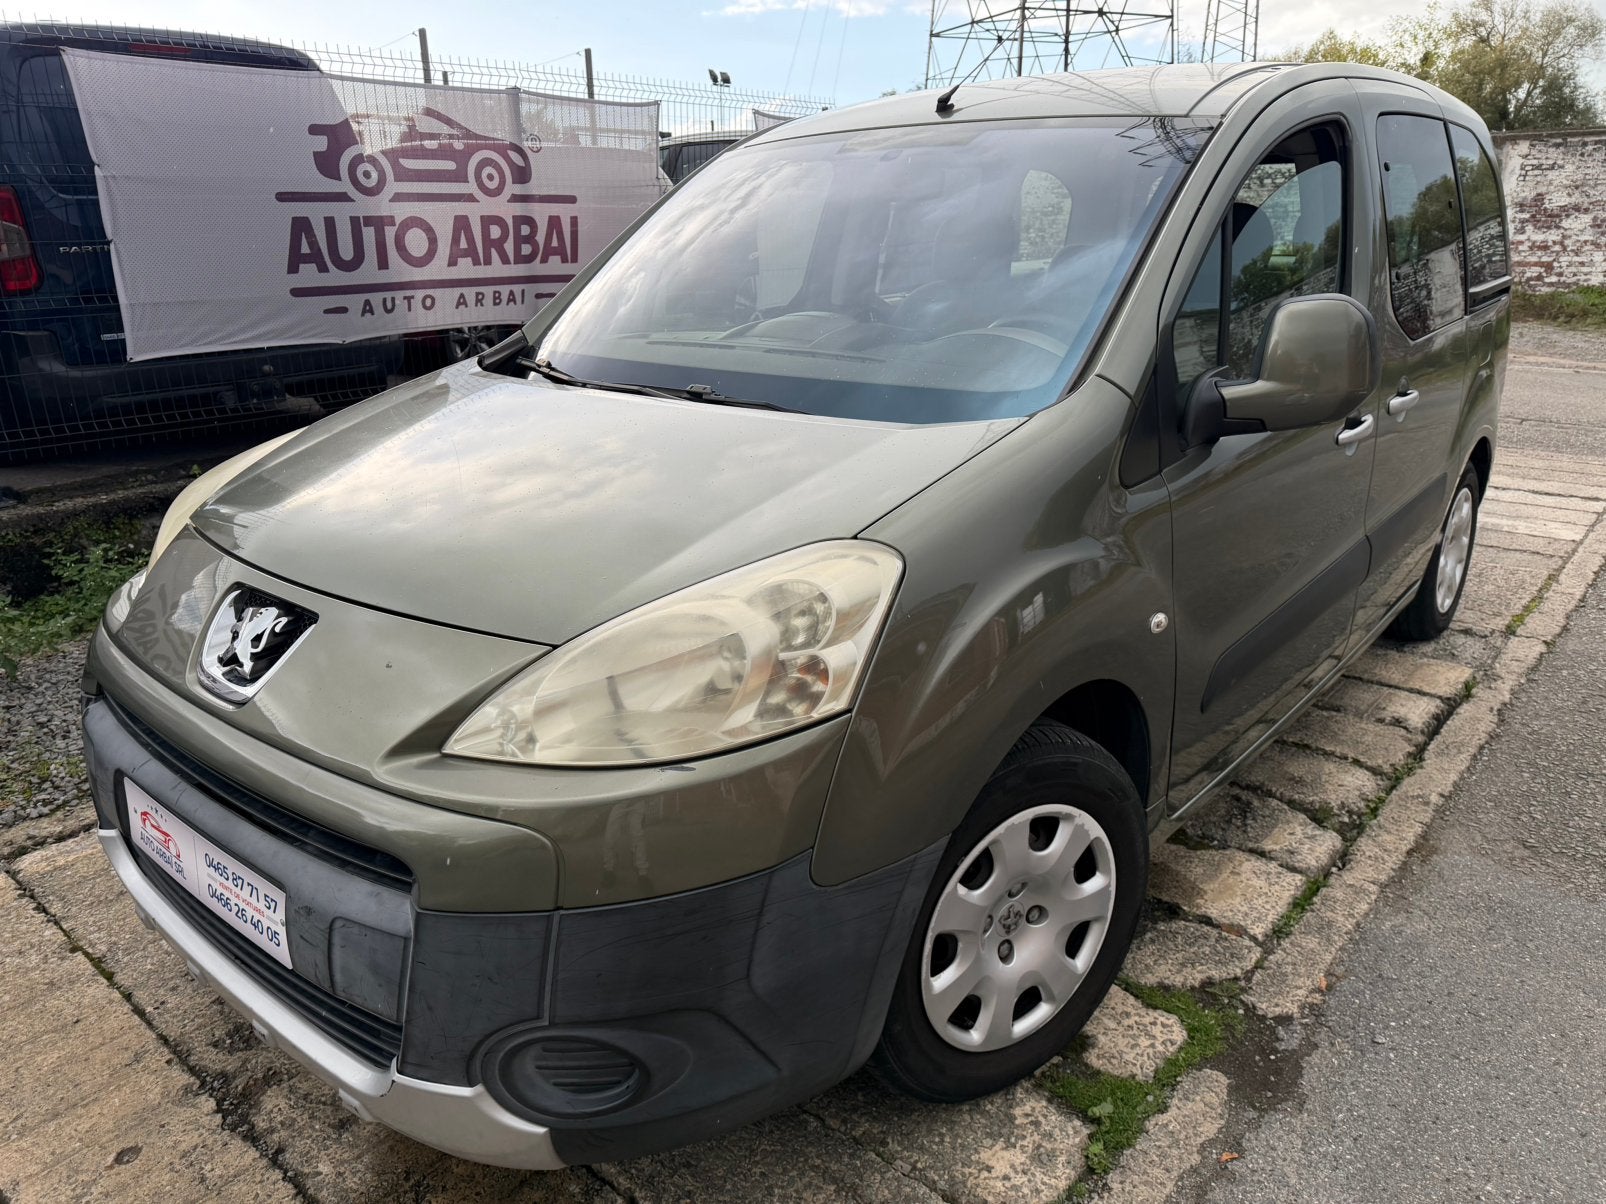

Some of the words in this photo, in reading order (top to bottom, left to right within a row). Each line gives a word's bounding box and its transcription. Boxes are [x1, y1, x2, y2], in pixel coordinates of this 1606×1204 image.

[287, 215, 438, 274] AUTO
[448, 214, 579, 268] ARBAI
[360, 293, 436, 318] AUTO
[455, 288, 526, 310] ARBAI
[140, 830, 155, 852] AUTO
[156, 845, 173, 869] ARBAI
[174, 861, 187, 880] SRL
[204, 852, 229, 882] 0465
[231, 871, 245, 892] 87
[247, 881, 260, 903] 71
[263, 893, 278, 914] 57
[218, 881, 233, 896] VENTE
[233, 892, 241, 901] DE
[241, 898, 265, 918] VOITURES
[207, 883, 233, 913] 0466
[234, 902, 248, 924] 26
[250, 914, 264, 935] 40
[266, 926, 281, 947] 05
